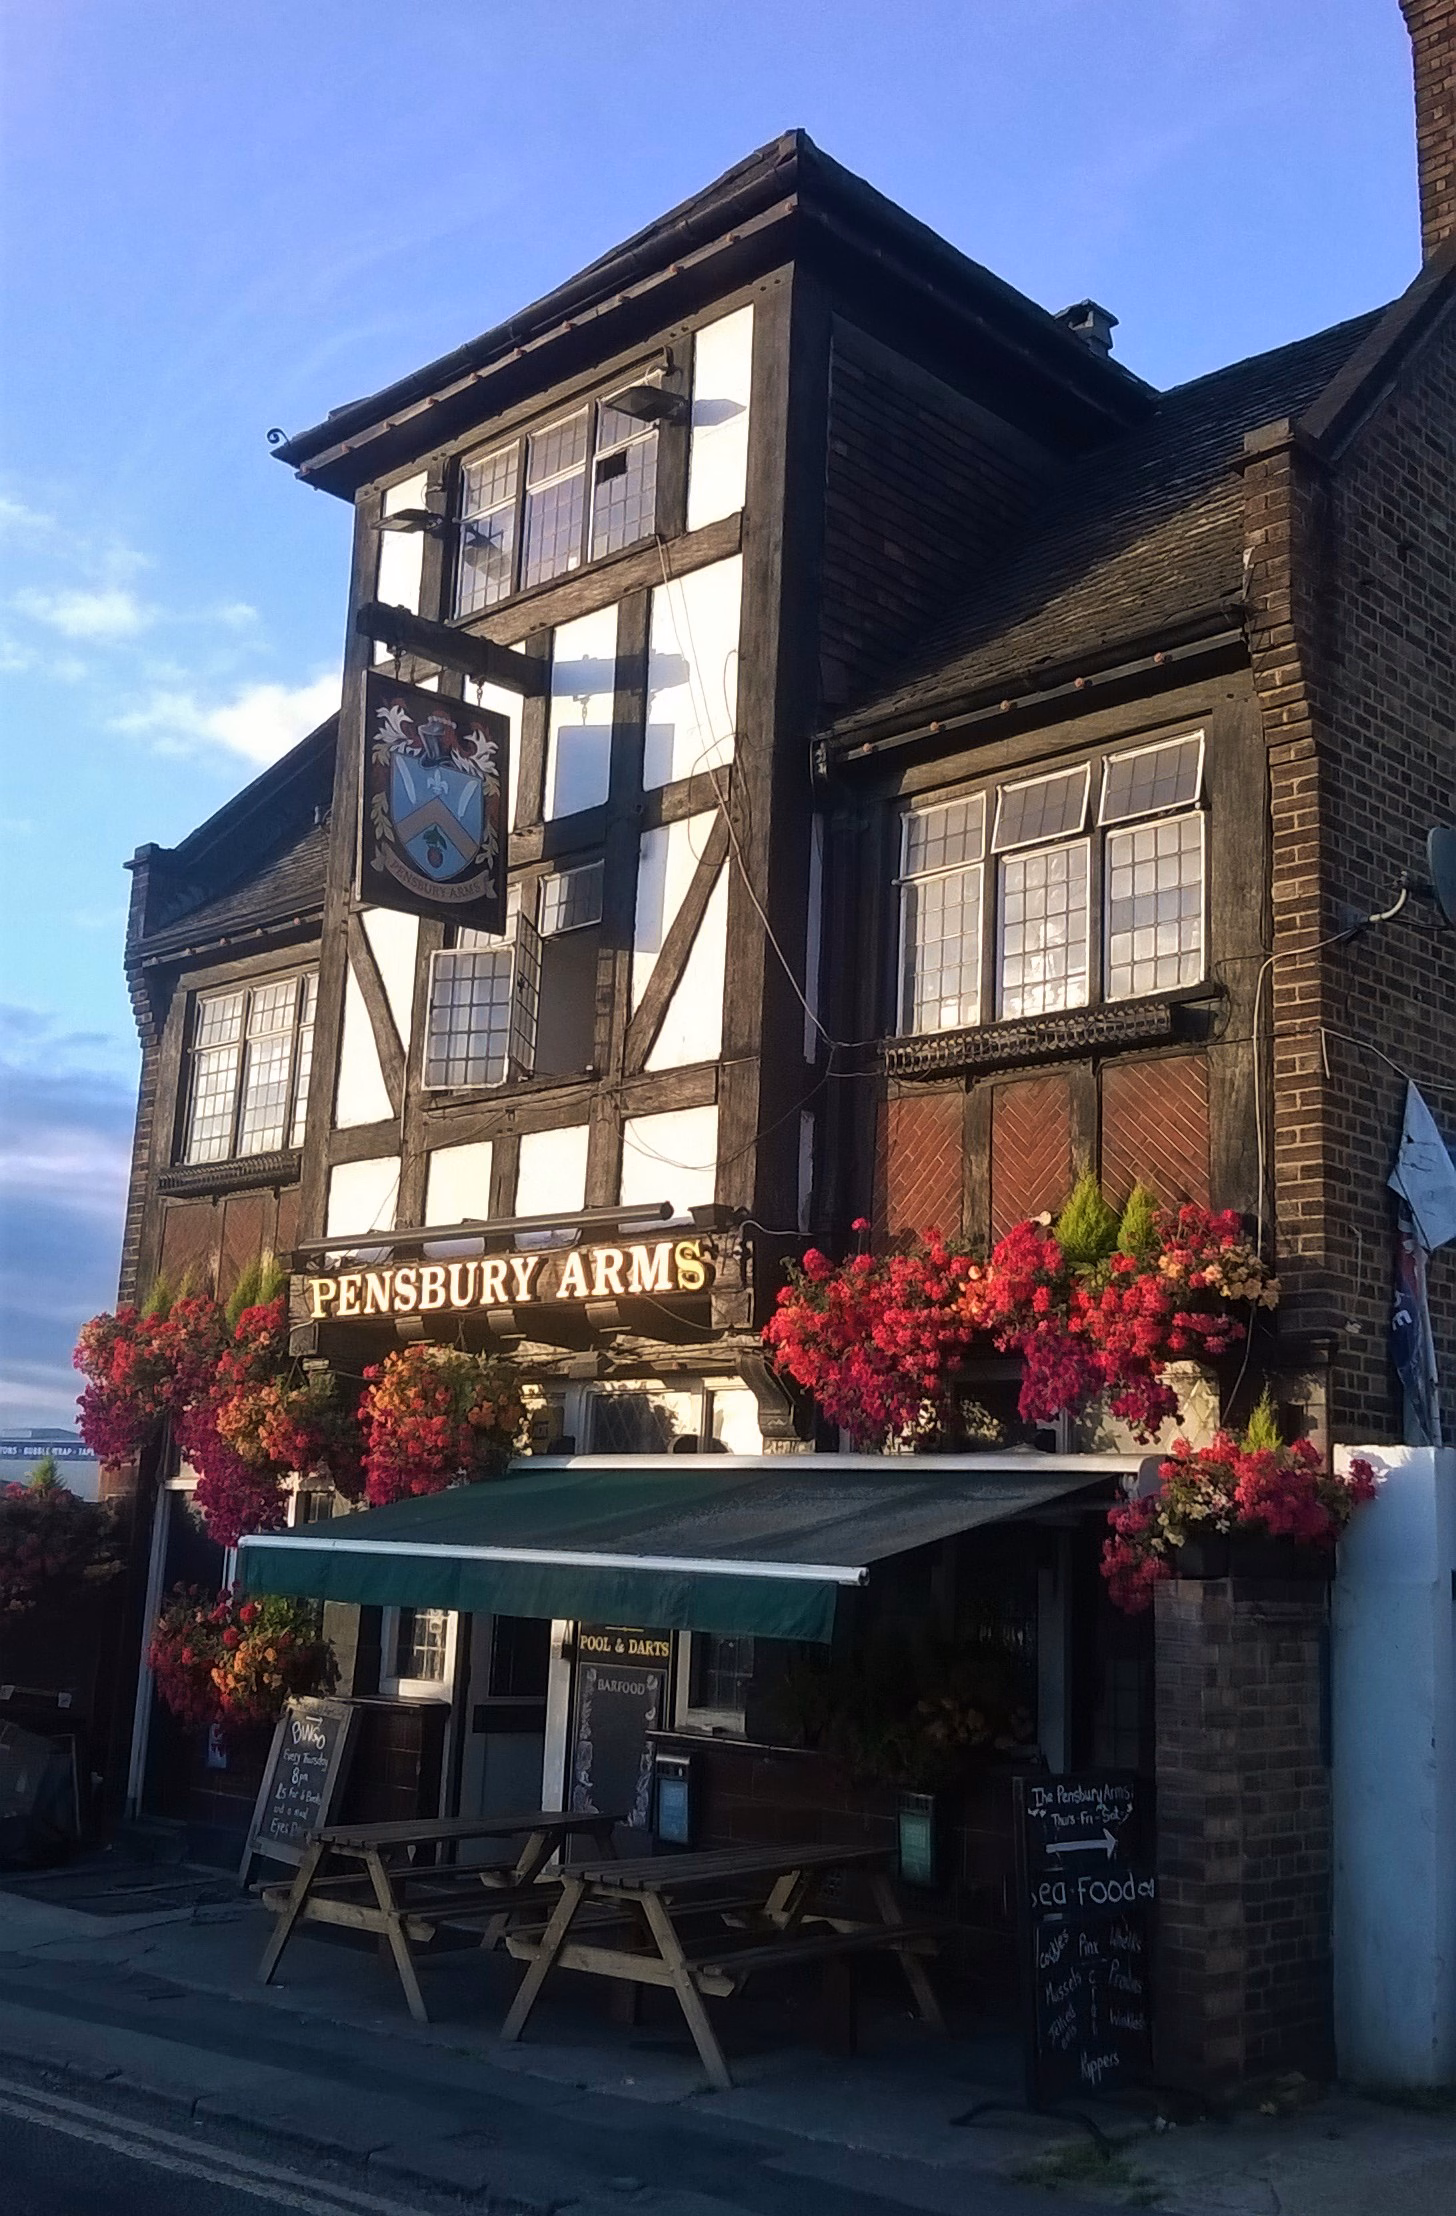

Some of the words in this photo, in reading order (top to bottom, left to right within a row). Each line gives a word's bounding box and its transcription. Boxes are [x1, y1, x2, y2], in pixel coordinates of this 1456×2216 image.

[389, 860, 447, 897] PENSBURY
[449, 882, 481, 898] ARMS
[310, 1255, 540, 1320] PENSBURY
[556, 1239, 706, 1300] ARMS
[580, 1635, 611, 1652] POOL
[614, 1637, 625, 1653] &
[628, 1639, 670, 1657] DARTS
[597, 1678, 645, 1696] BARFOOD
[1031, 1787, 1054, 1808] The
[1056, 1784, 1104, 1806] Pensbury
[1080, 2048, 1120, 2088] Kippers
